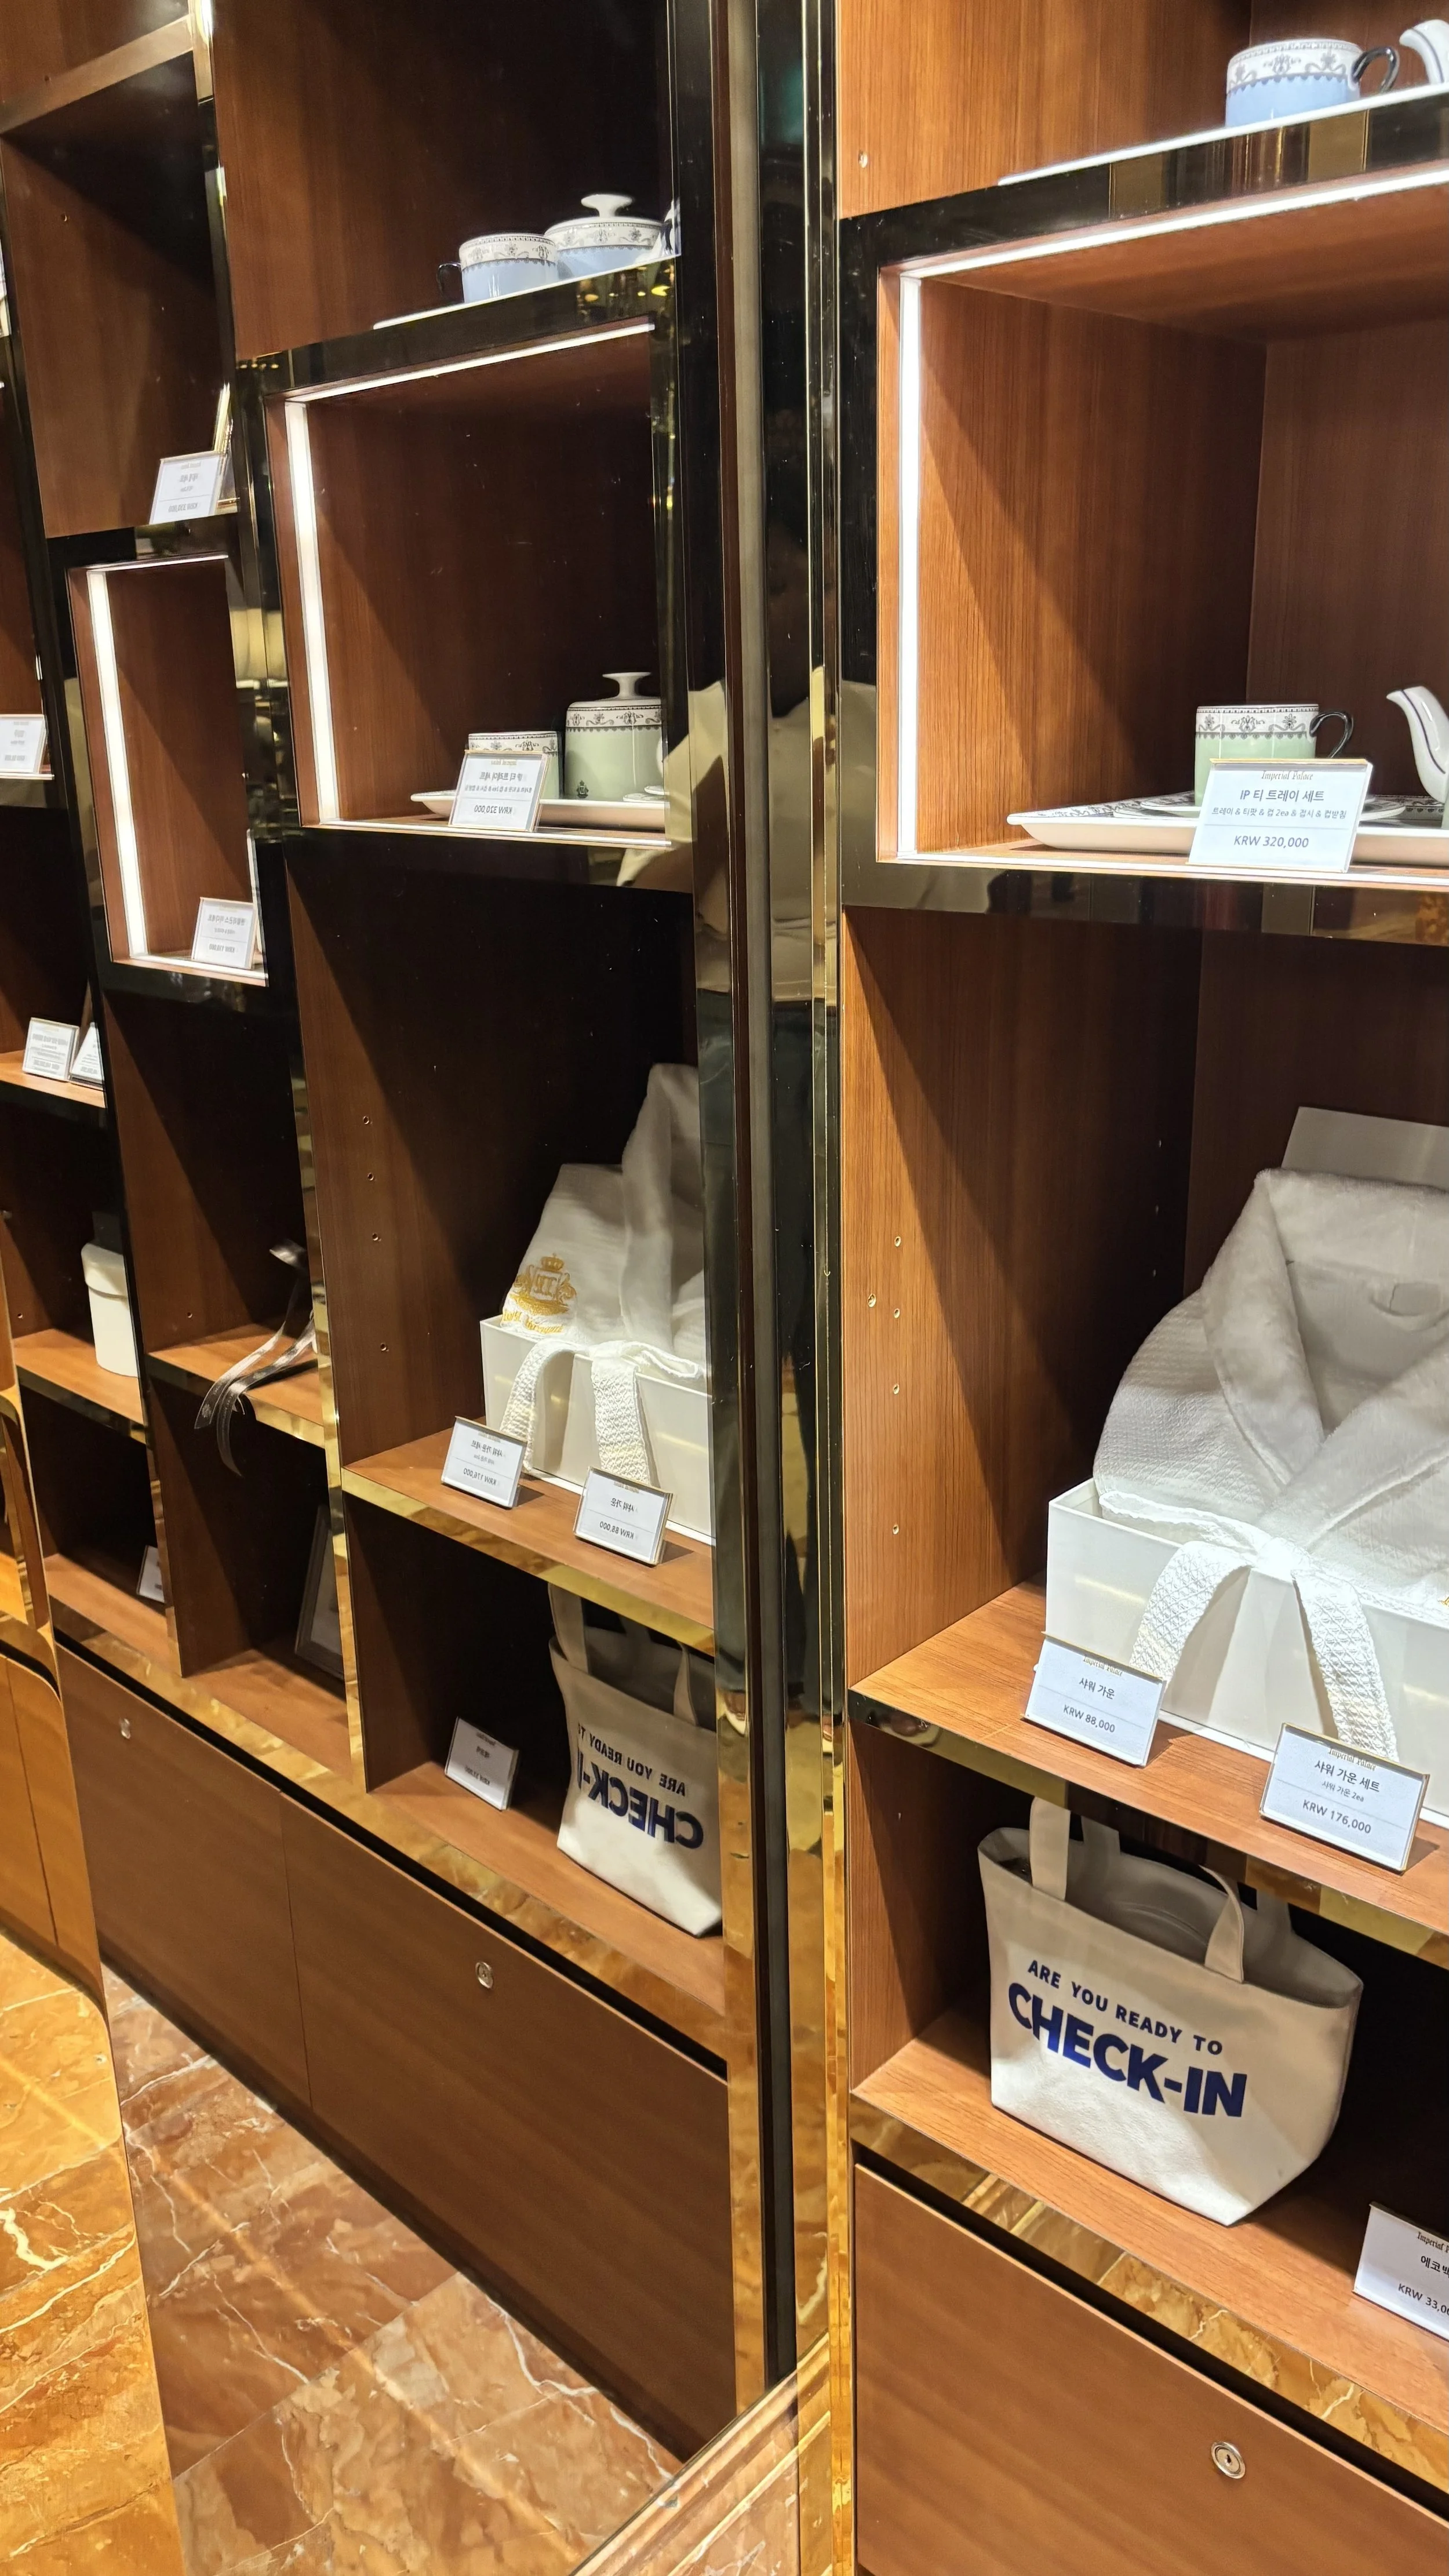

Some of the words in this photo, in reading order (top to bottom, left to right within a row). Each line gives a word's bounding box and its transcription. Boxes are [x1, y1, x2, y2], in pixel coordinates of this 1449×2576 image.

[1261, 770, 1291, 781] Imperial
[1240, 790, 1250, 800] IP
[1253, 789, 1264, 801] 티
[1266, 789, 1299, 802] 트레이
[1302, 790, 1325, 802] 세트
[1211, 807, 1233, 816] 트레이
[1234, 836, 1261, 846] KRW
[1262, 836, 1309, 849] 320,000
[1079, 1678, 1096, 1693] 샤워
[1097, 1684, 1115, 1700] 가운
[1063, 1704, 1084, 1719] KRW
[1086, 1714, 1115, 1733] 88,000
[1315, 1760, 1334, 1776] 샤워
[1337, 1767, 1357, 1785] 가운
[1359, 1775, 1380, 1792] 세트
[1352, 1792, 1364, 1802] 2ea
[1303, 1799, 1328, 1816] KRW
[1330, 1811, 1371, 1833] 176,000
[1027, 1960, 1061, 1989] ARE
[1071, 1981, 1108, 2012] YOU
[1116, 2004, 1182, 2044] READY
[1193, 2035, 1223, 2055] TO
[1009, 1982, 1247, 2117] CHECK-IN
[1417, 2231, 1444, 2250] Imperial
[1398, 2283, 1422, 2301] KRW
